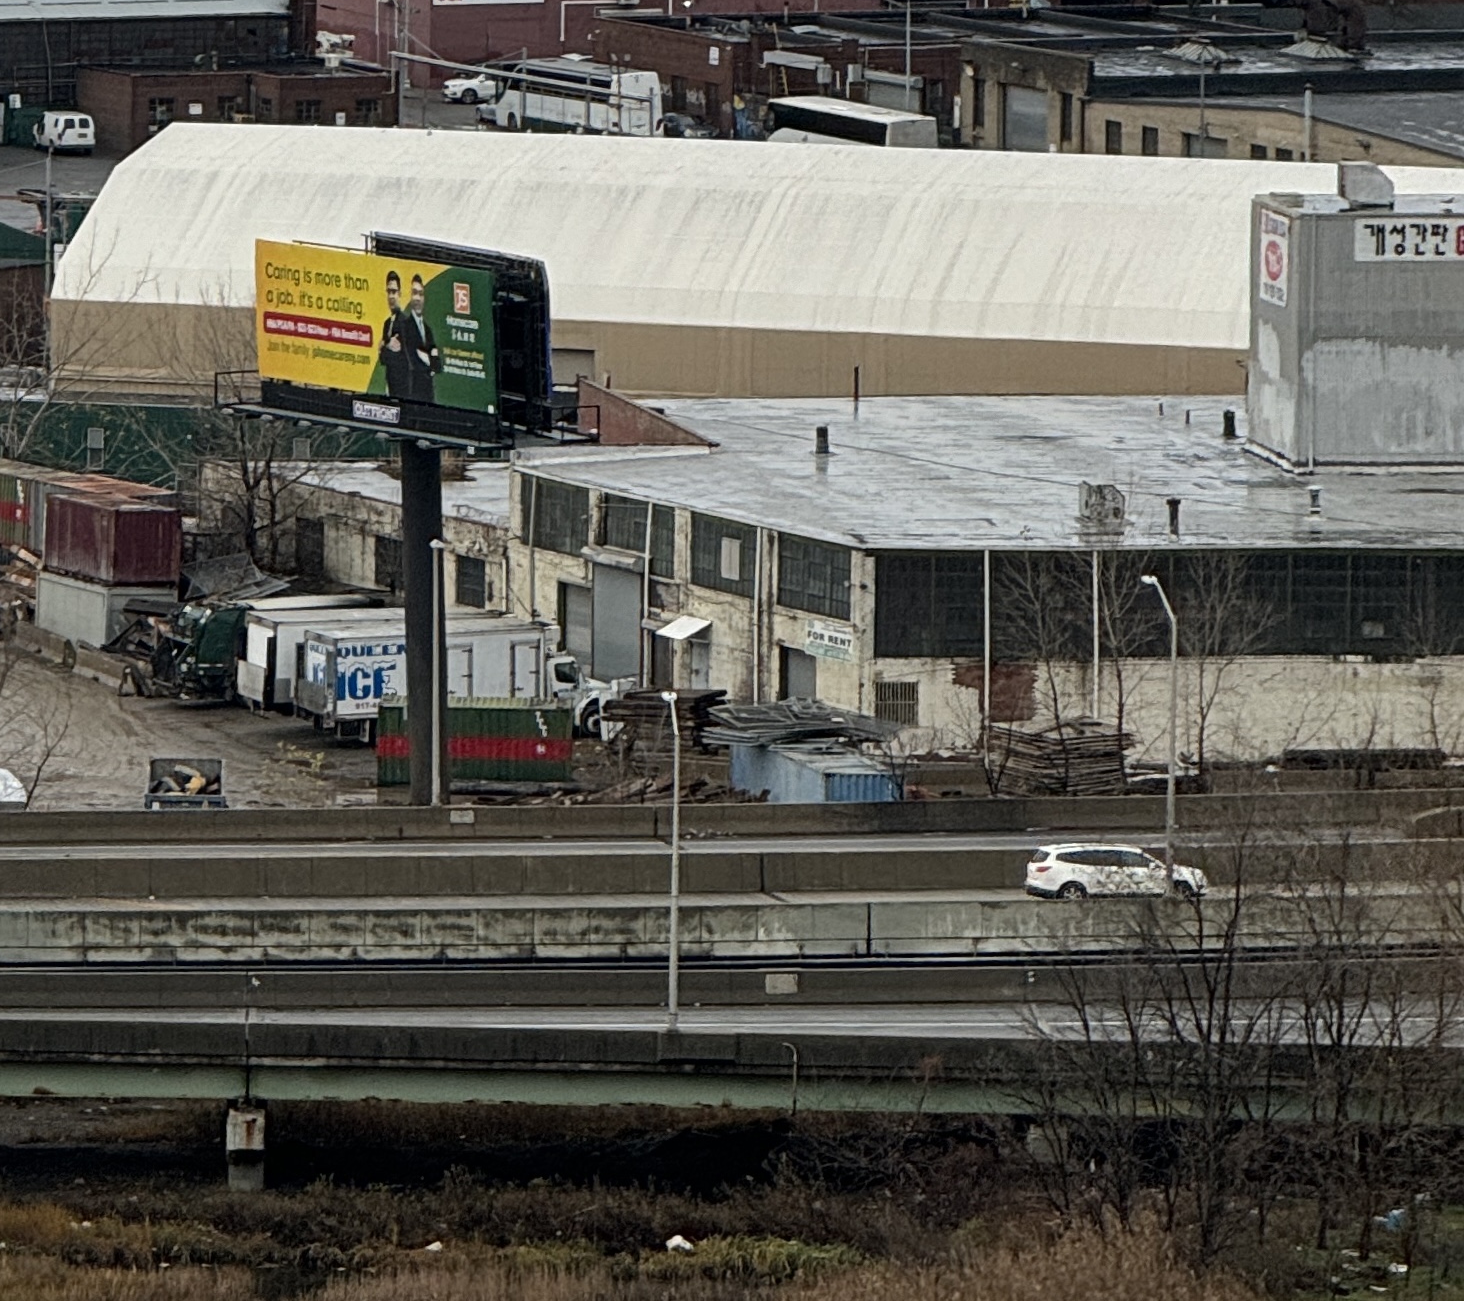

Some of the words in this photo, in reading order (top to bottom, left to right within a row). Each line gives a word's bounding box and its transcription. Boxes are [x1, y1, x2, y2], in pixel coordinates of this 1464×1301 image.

[1363, 223, 1449, 256] 개성간판
[265, 262, 300, 287] Caring
[303, 266, 312, 284] is
[314, 272, 341, 288] more
[344, 273, 369, 291] than
[266, 289, 274, 303] a
[275, 287, 296, 308] job,
[299, 290, 313, 308] it's
[315, 296, 324, 309] a
[325, 296, 366, 320] calling.
[807, 630, 825, 642] FOR
[828, 635, 852, 648] RENT
[336, 659, 397, 700] ICE
